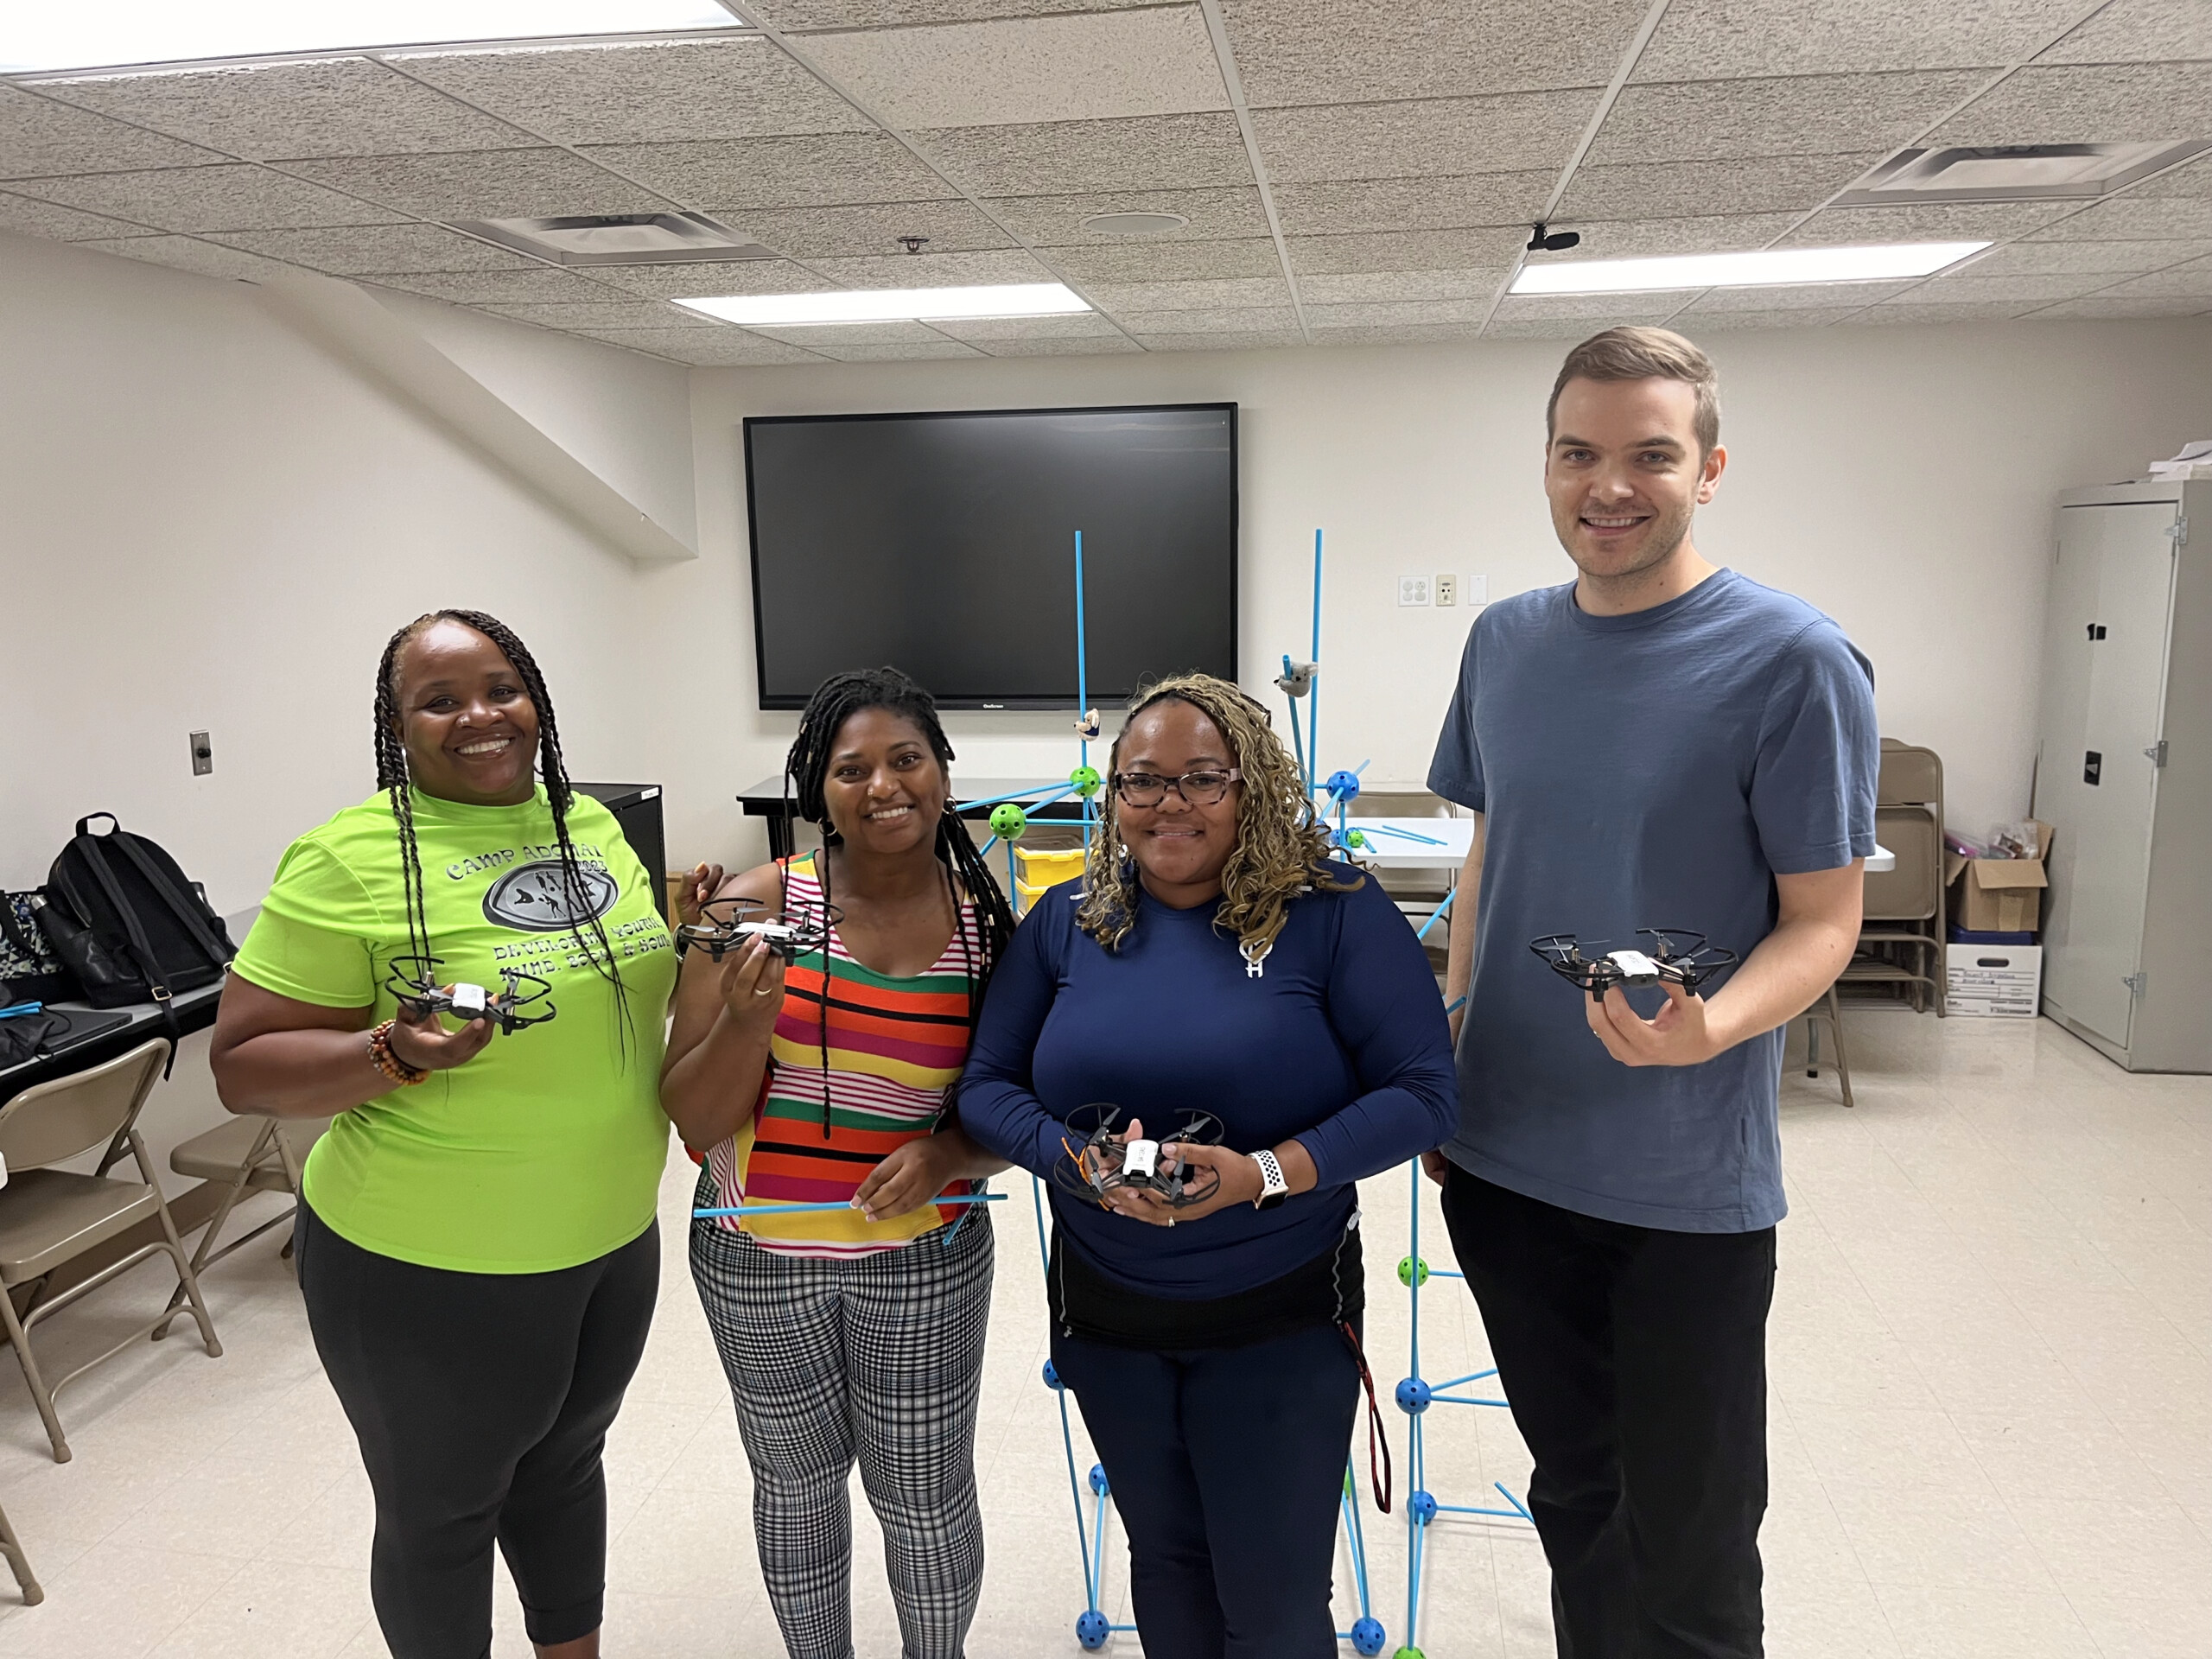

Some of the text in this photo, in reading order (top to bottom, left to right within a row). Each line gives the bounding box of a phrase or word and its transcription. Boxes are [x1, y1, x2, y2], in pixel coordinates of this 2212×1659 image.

[446, 849, 515, 880] CAMP
[577, 860, 607, 873] 2023
[493, 931, 607, 960] DEVELOPIN
